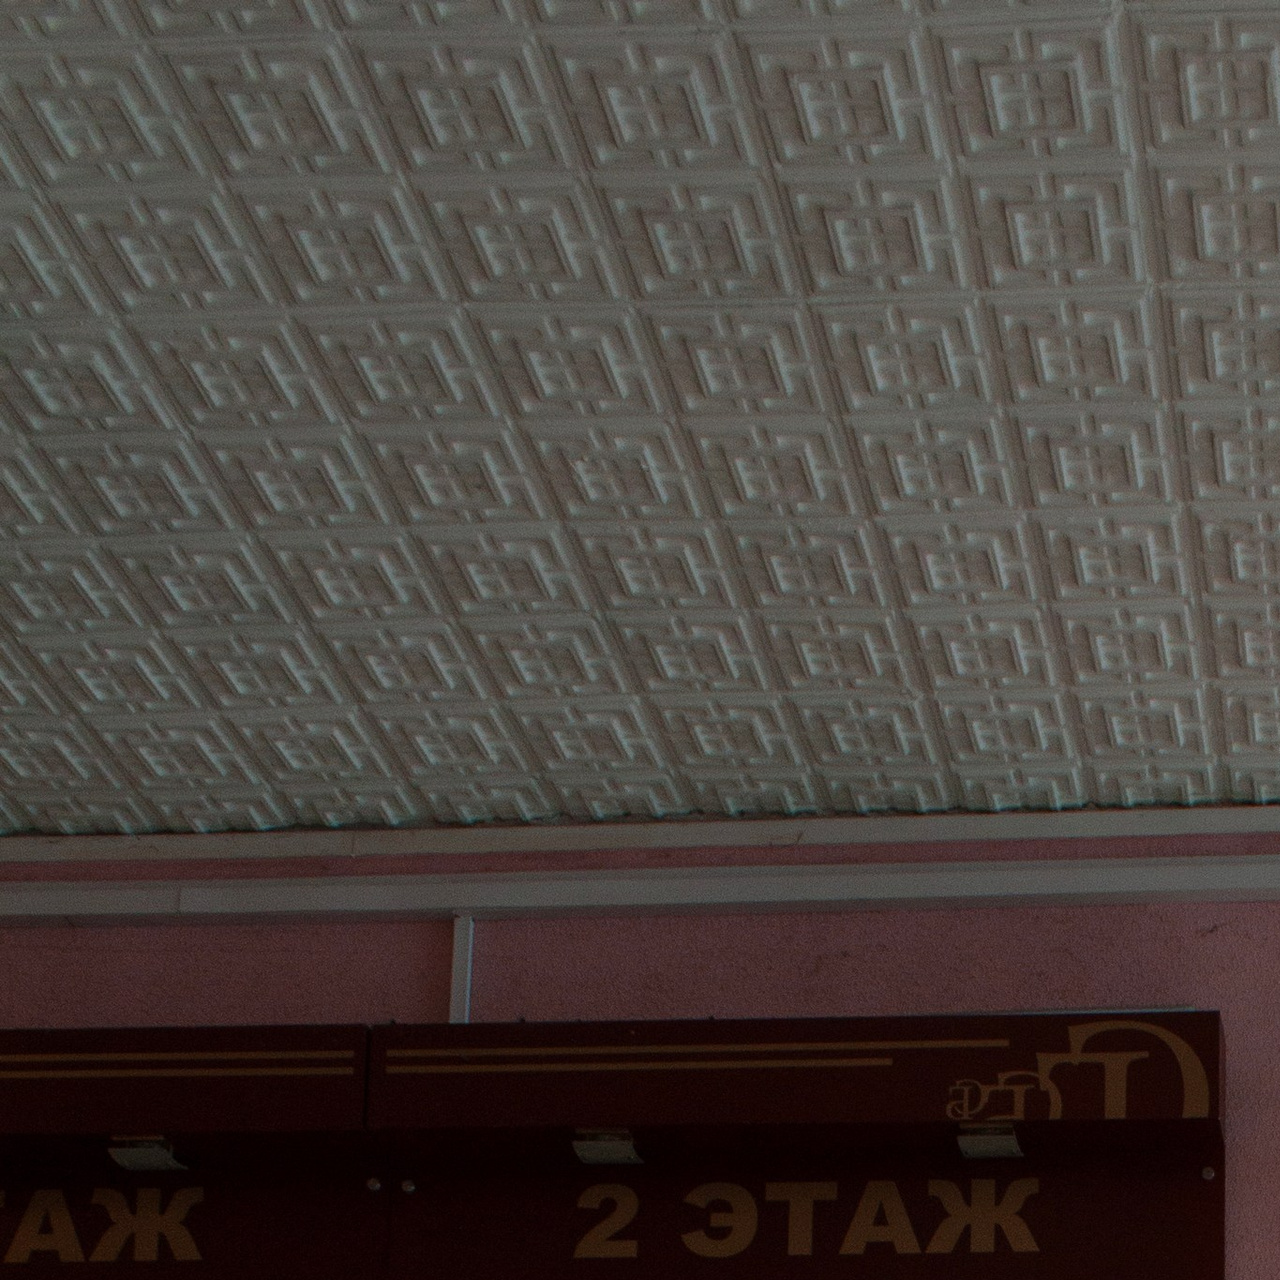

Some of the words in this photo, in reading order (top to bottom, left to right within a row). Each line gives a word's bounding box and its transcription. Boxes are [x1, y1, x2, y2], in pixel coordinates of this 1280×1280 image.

[0, 1187, 204, 1264] АЖ
[573, 1184, 640, 1259] 2
[681, 1177, 1040, 1259] ЭТАЖ
